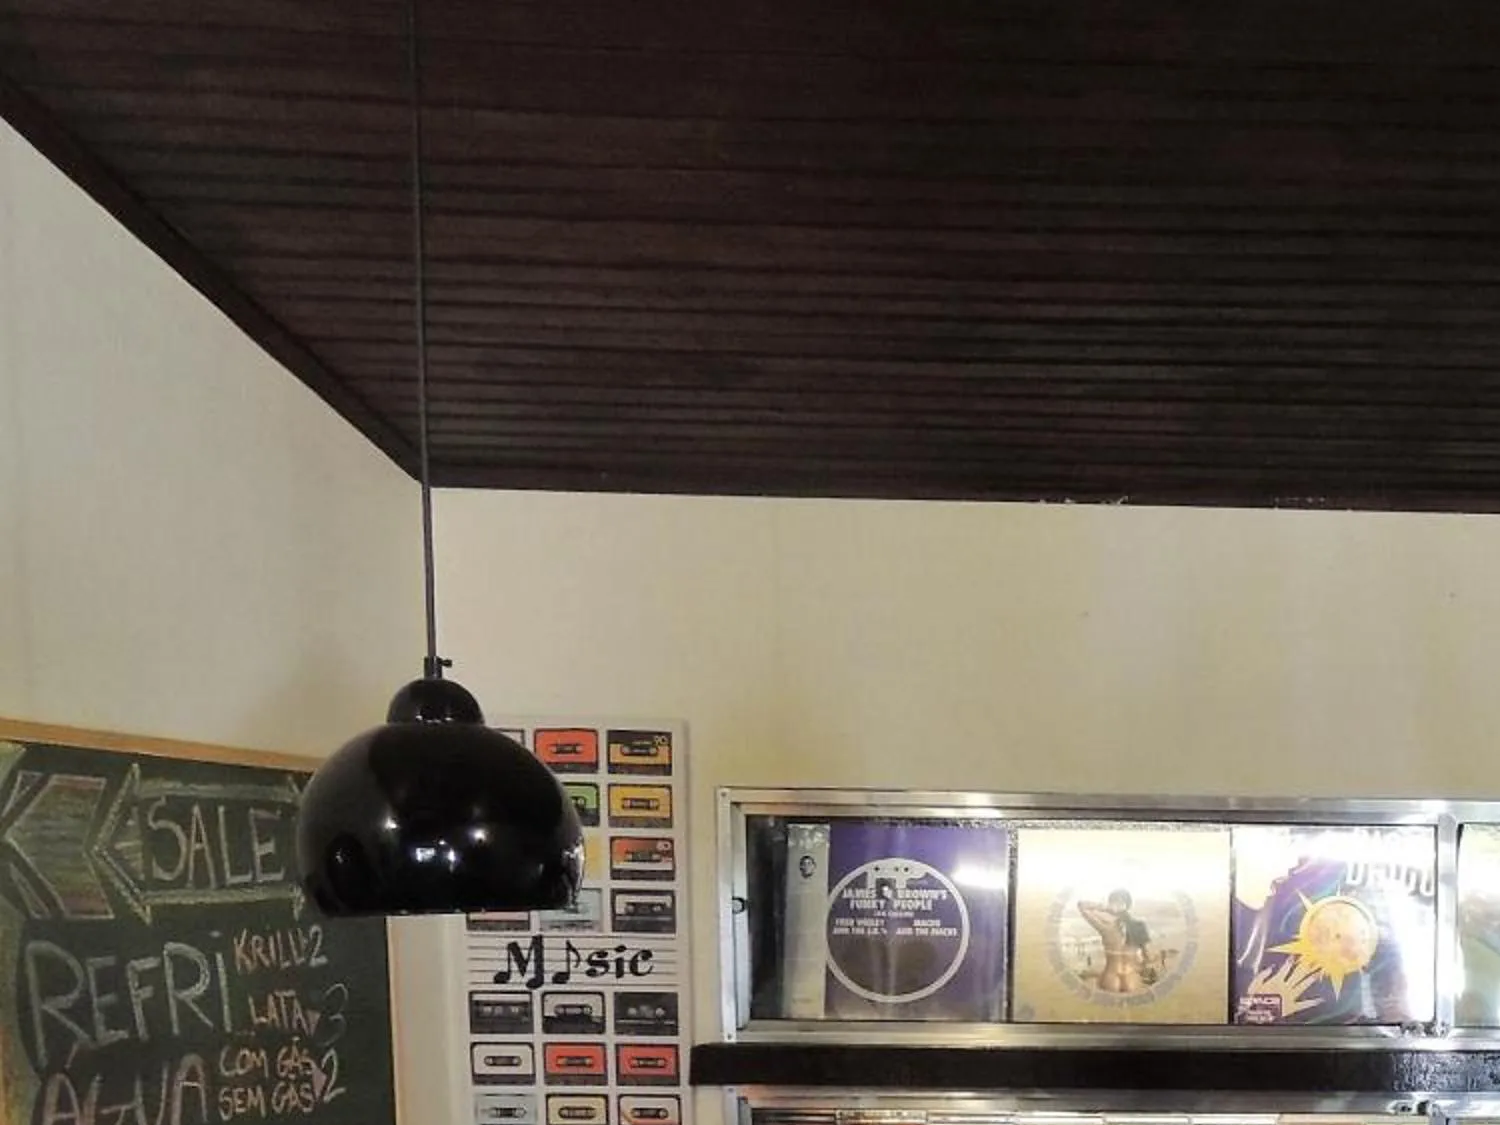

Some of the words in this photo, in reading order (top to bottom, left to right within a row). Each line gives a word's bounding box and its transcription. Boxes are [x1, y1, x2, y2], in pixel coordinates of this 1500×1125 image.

[147, 797, 286, 890] SALE
[26, 932, 233, 1068] REFRI
[308, 923, 329, 969] 2
[248, 988, 311, 1036] LATA
[219, 1084, 266, 1121] SEM
[220, 1045, 269, 1078] COM
[320, 1047, 347, 1104] 2
